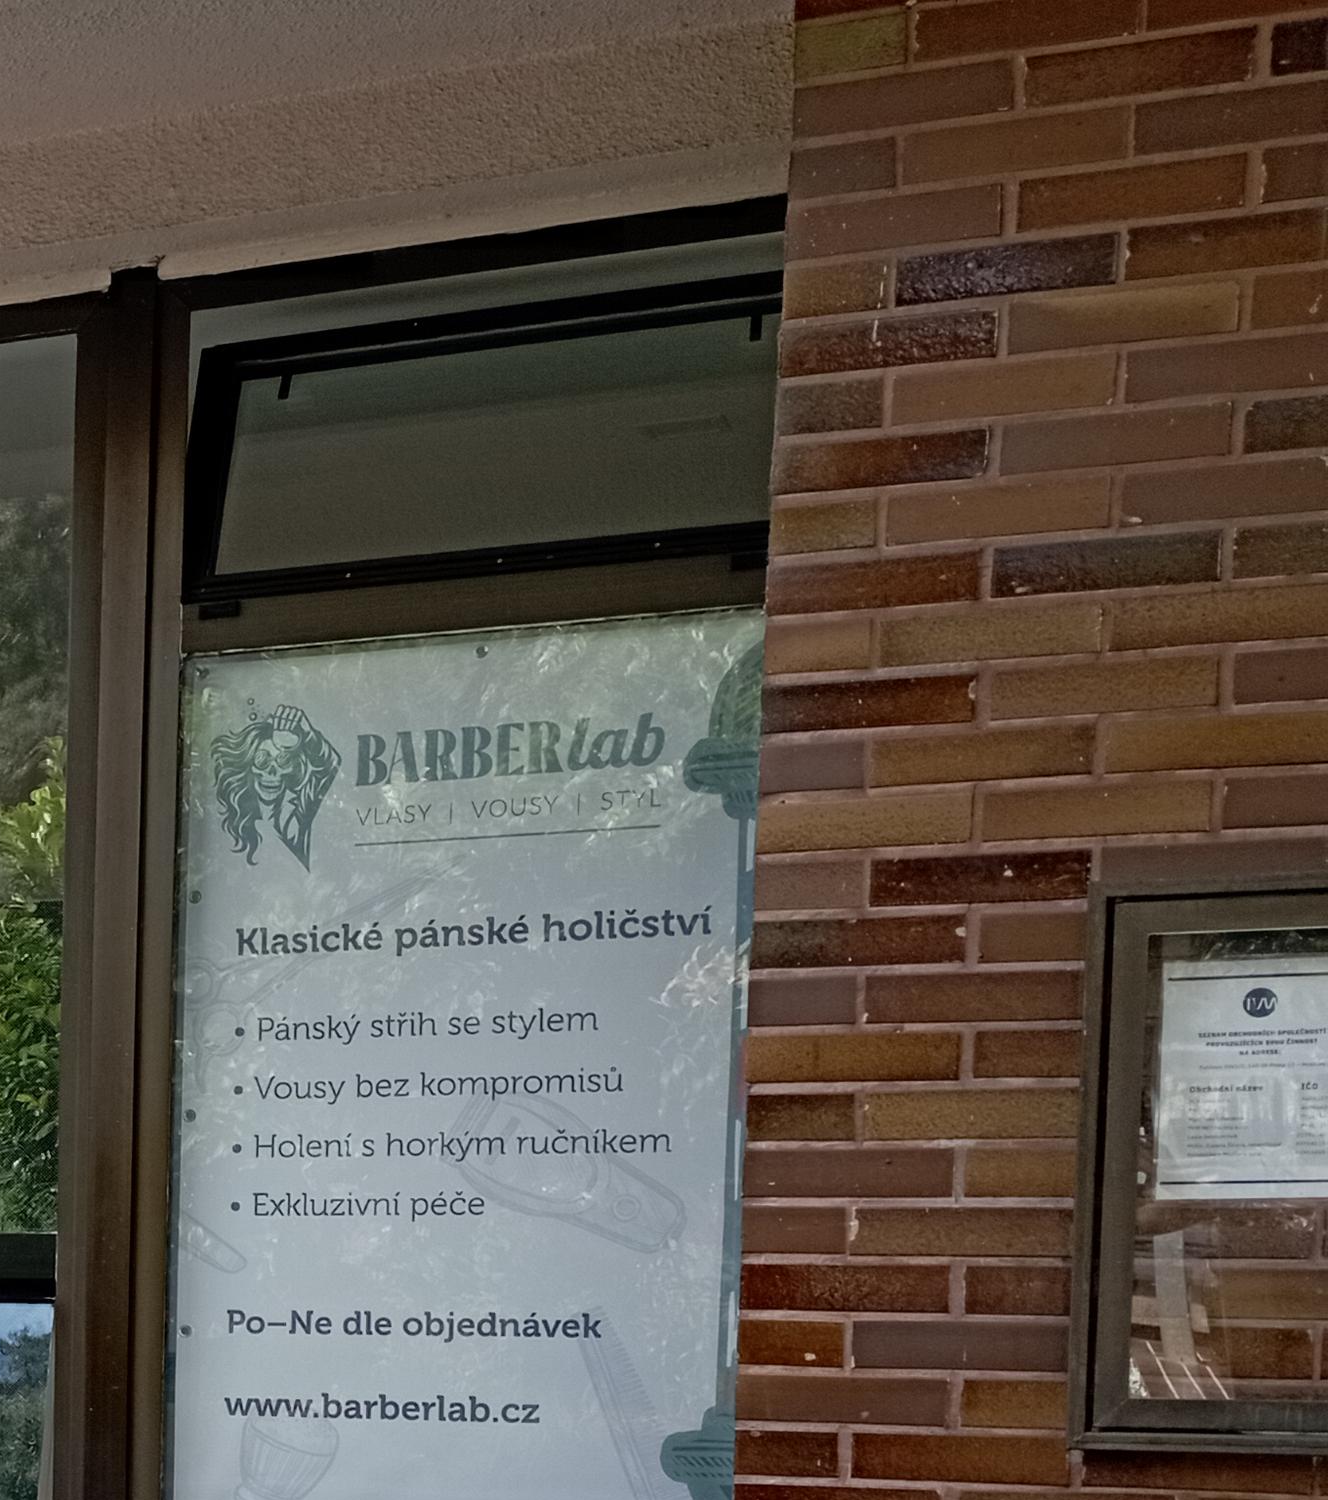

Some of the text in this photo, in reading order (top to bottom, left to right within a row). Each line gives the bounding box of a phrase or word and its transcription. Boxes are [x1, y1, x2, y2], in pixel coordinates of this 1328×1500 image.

[355, 711, 666, 787] BARBERlab
[356, 788, 662, 826] VLASY VOUSY STYL
[236, 904, 713, 957] Klasické pánské holičství
[257, 1008, 599, 1045] Pánský střih se stylem
[254, 1067, 624, 1105] Vousy bez kompromisů
[253, 1128, 673, 1162] Holení s horkým ručníkem
[252, 1191, 485, 1222] Exkluzivní péče
[343, 1309, 392, 1337] dle
[403, 1311, 602, 1344] objednávek
[224, 1392, 541, 1424] www.barberlab.cz
